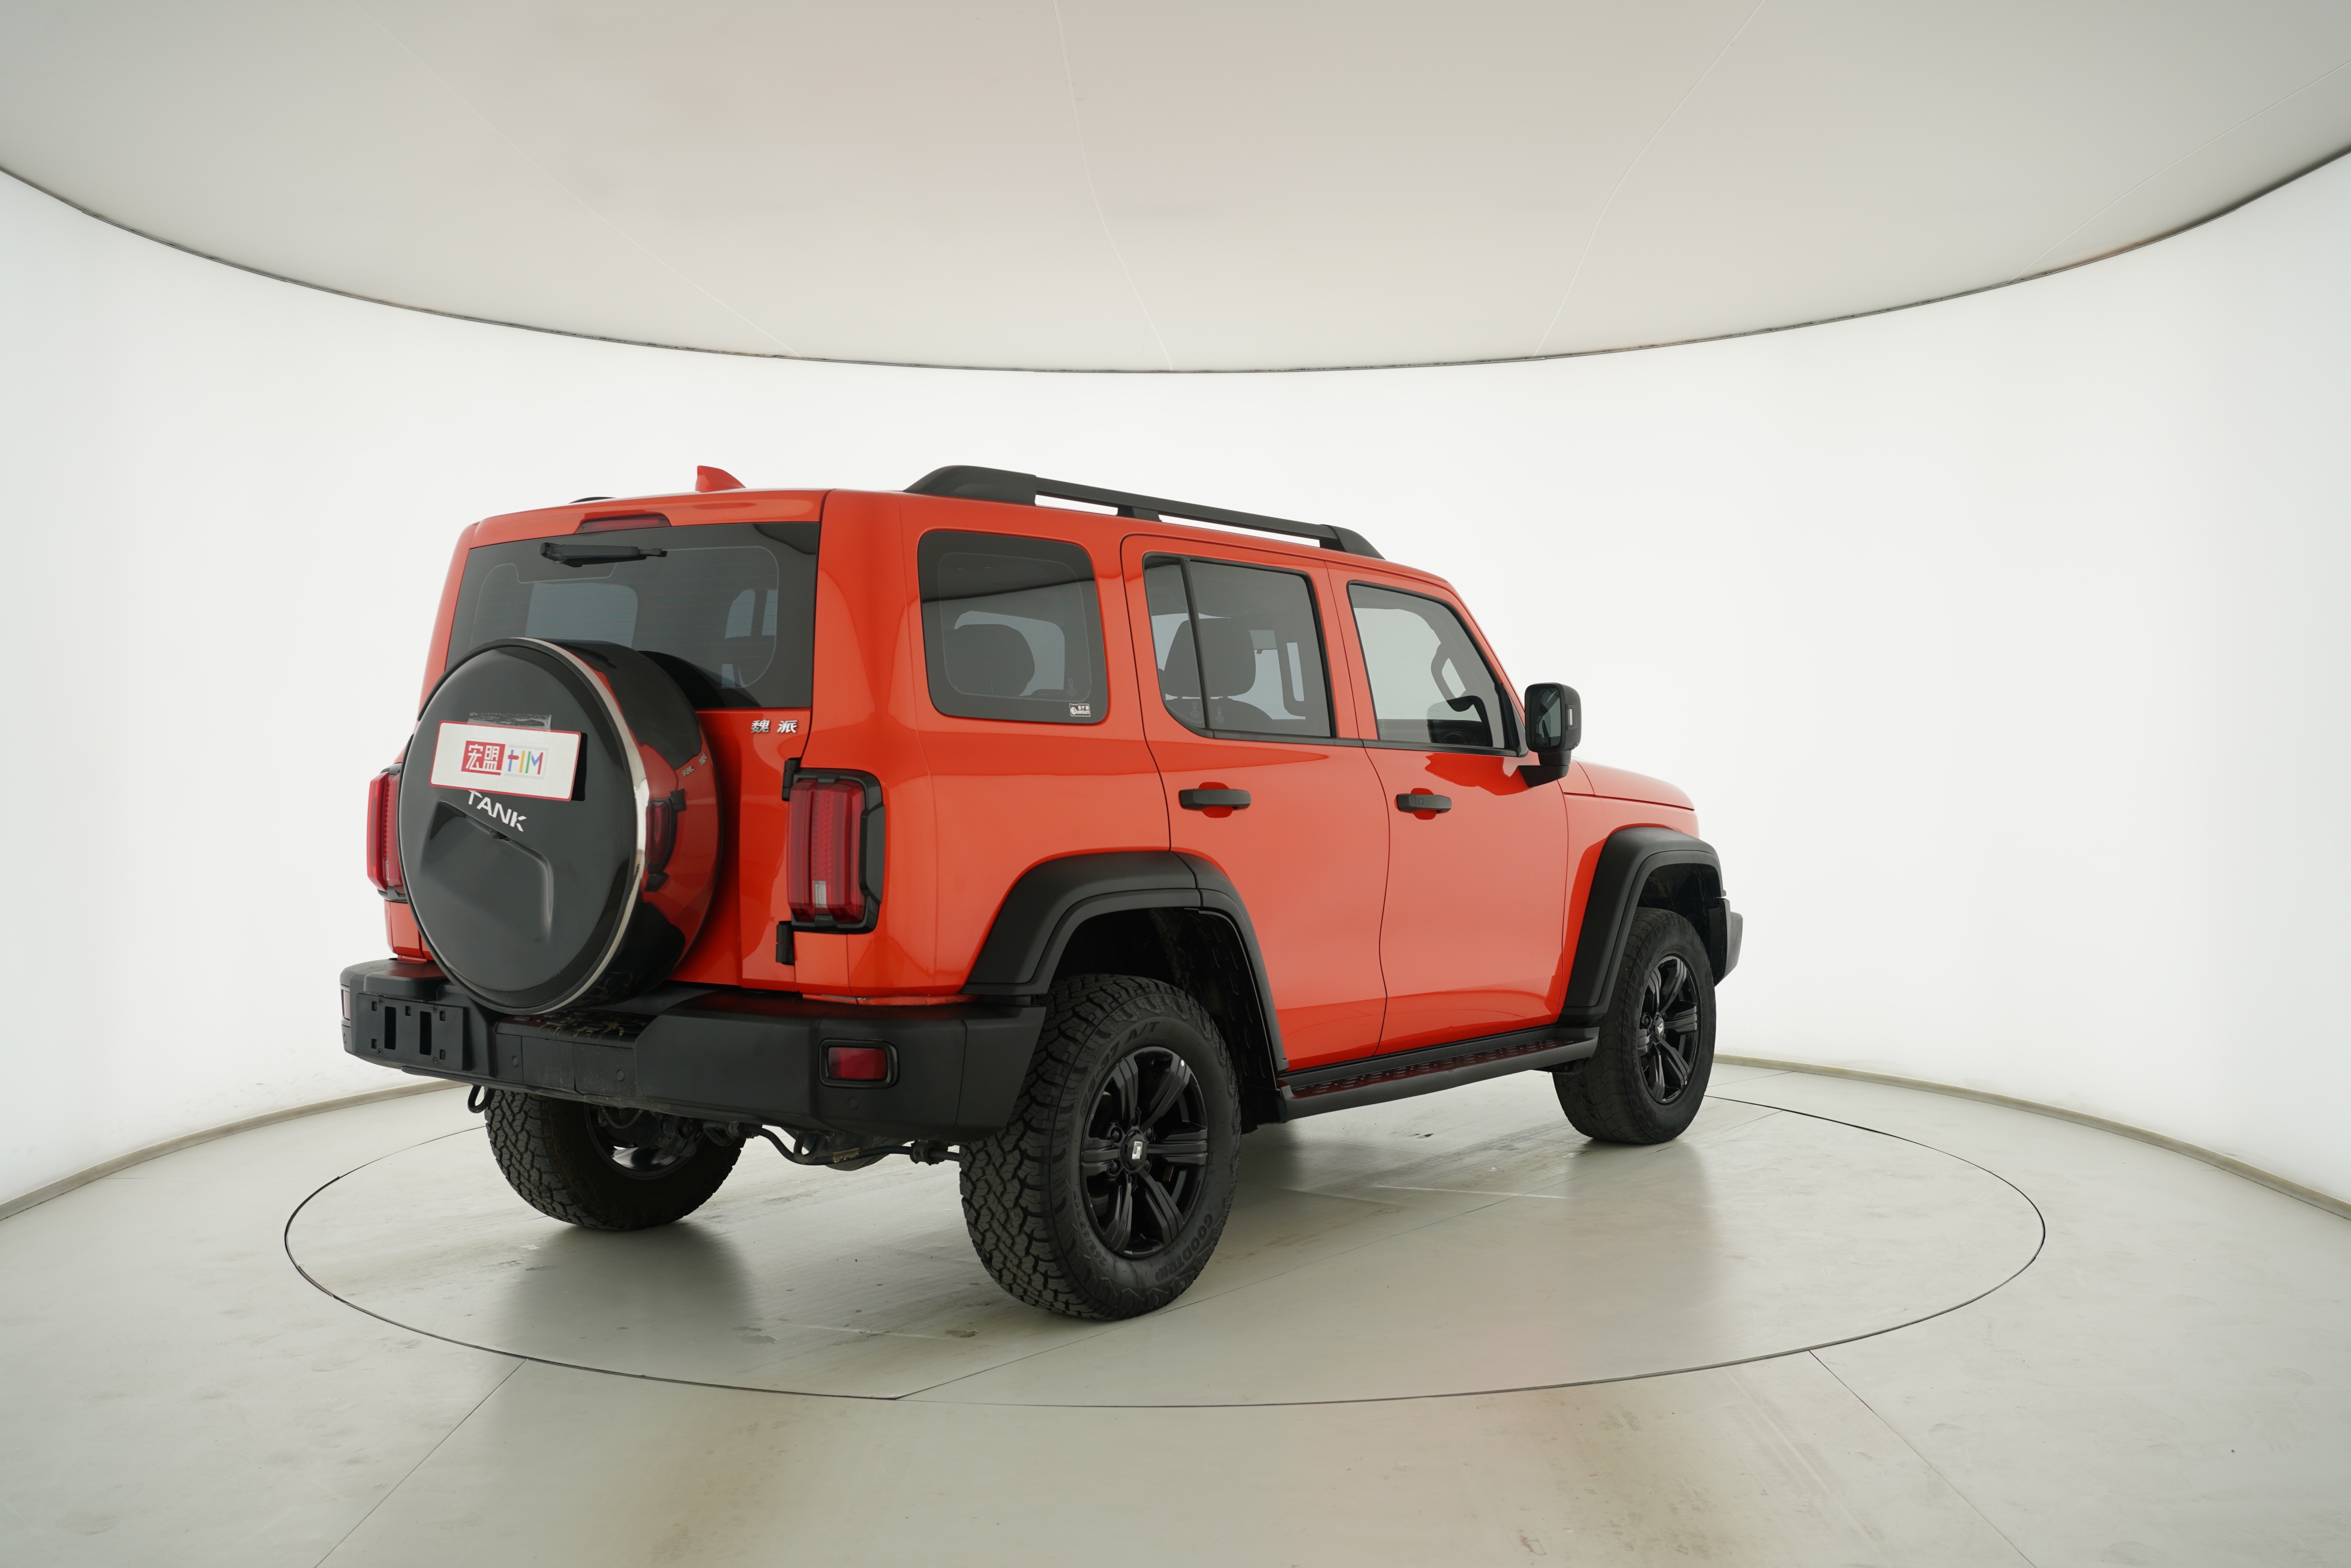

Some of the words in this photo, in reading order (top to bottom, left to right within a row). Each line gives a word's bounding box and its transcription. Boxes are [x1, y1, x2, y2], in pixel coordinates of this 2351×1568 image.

[465, 743, 500, 772] 宏盟
[467, 790, 527, 832] TANK
[1124, 1021, 1160, 1045] A/T
[1155, 1213, 1213, 1282] GOODTRIP
